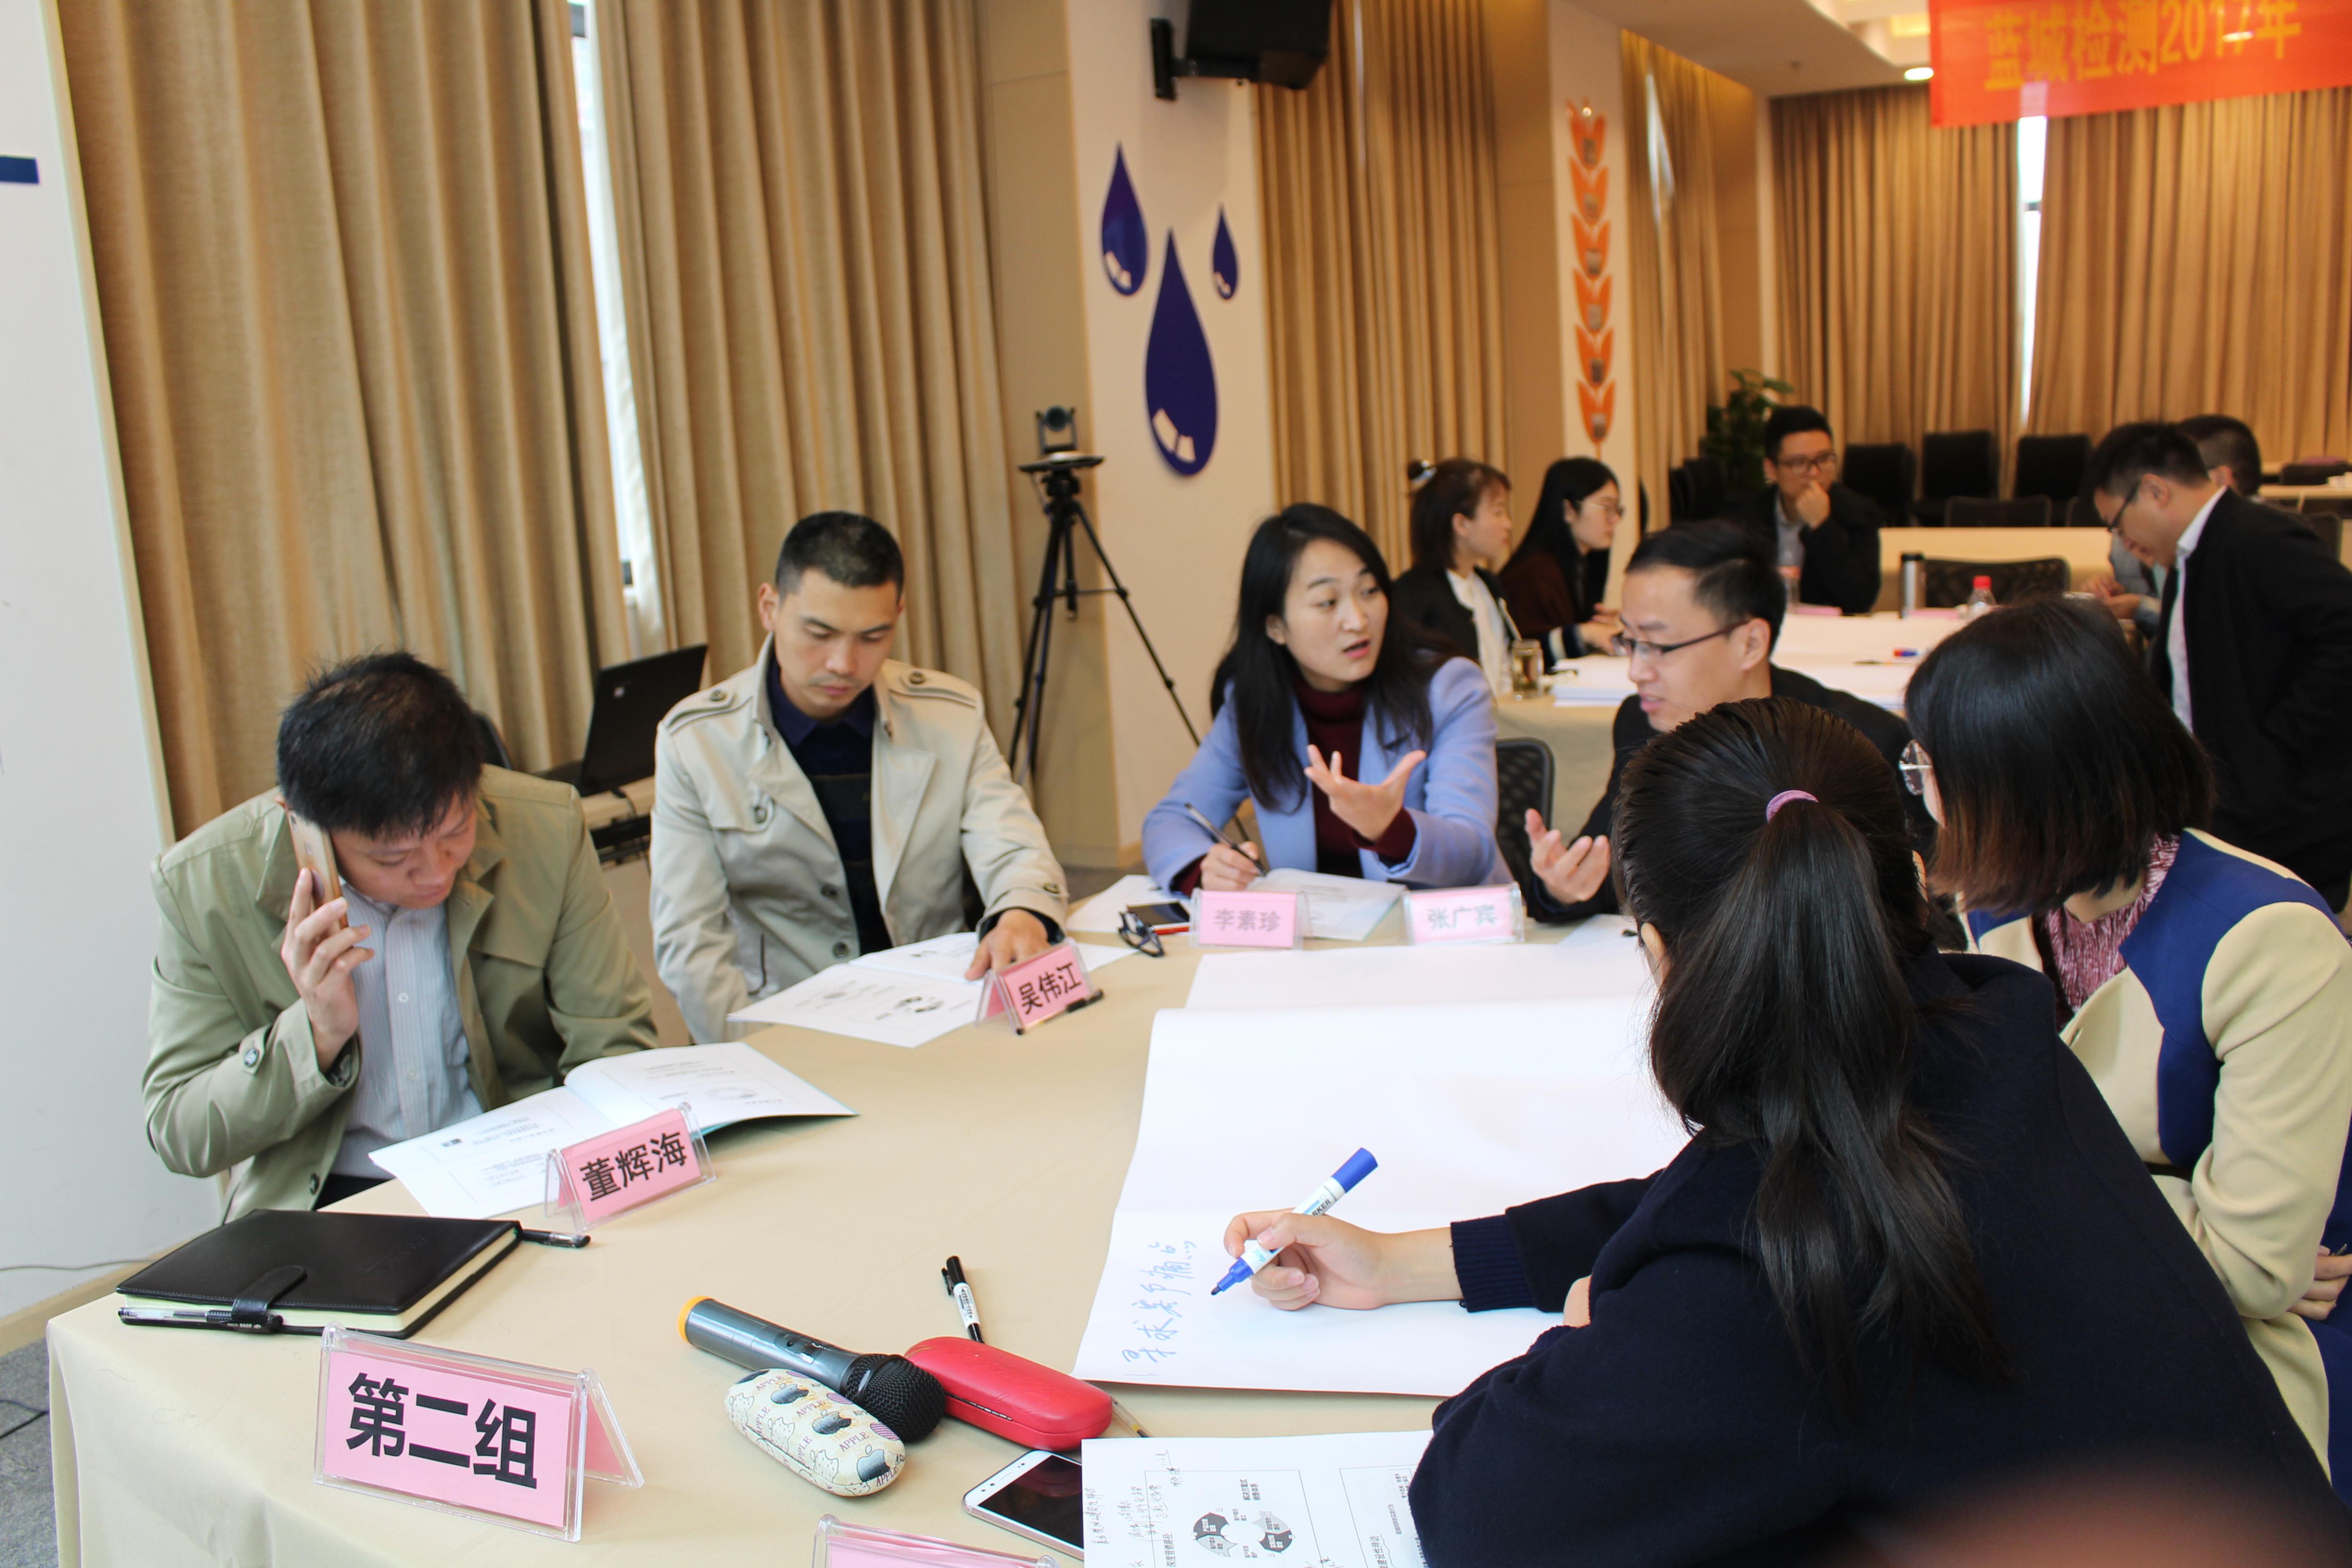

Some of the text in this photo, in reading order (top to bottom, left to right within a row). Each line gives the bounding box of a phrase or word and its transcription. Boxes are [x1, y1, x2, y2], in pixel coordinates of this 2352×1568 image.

[1213, 908, 1280, 932] 李素珍
[1018, 961, 1083, 1014] 吴伟江
[579, 1130, 688, 1202] 董辉海
[755, 1375, 784, 1391] APPLE
[795, 1400, 826, 1417] APPLE
[346, 1372, 537, 1489] 第二组
[839, 1431, 870, 1452] APPLE
